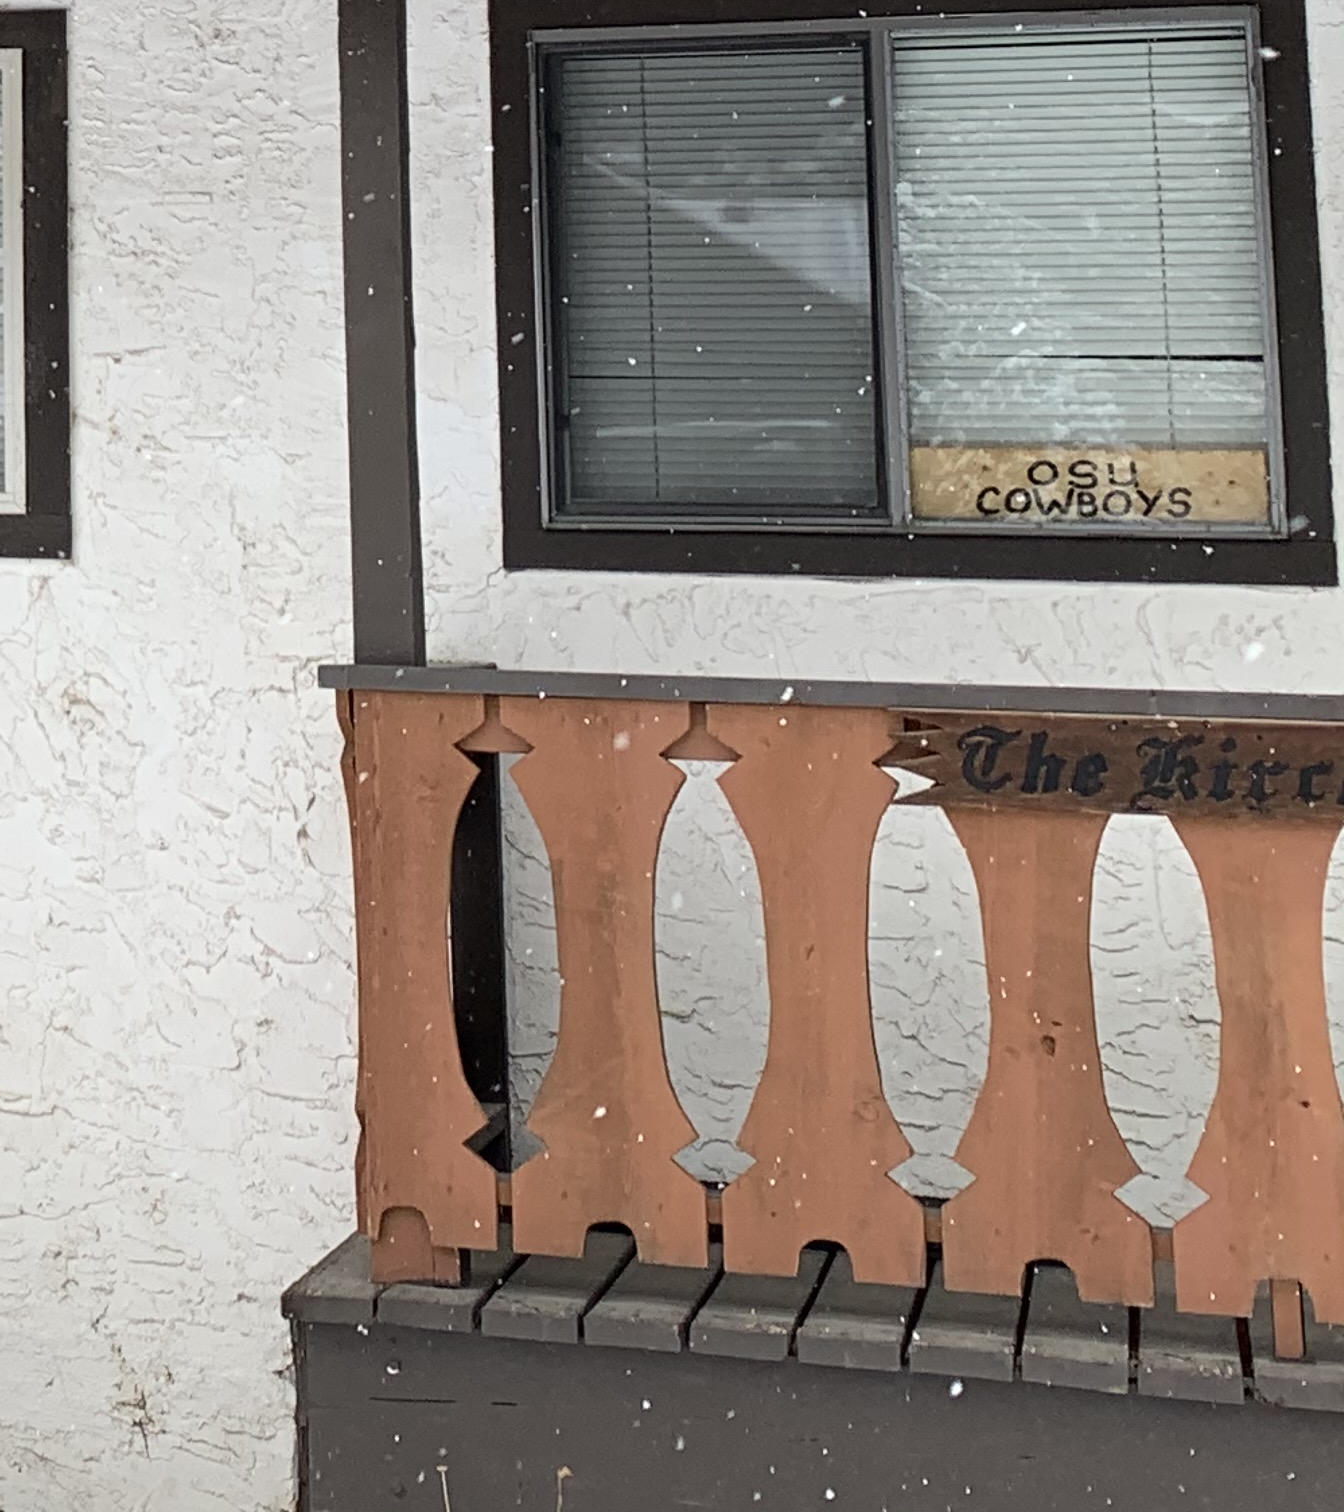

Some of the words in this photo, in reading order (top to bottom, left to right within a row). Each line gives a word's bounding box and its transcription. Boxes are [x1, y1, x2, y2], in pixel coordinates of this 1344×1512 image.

[1027, 460, 1139, 489] OSU
[976, 487, 1193, 519] COWBOYS
[957, 725, 1108, 796] The
[1132, 734, 1344, 810] Kirc
